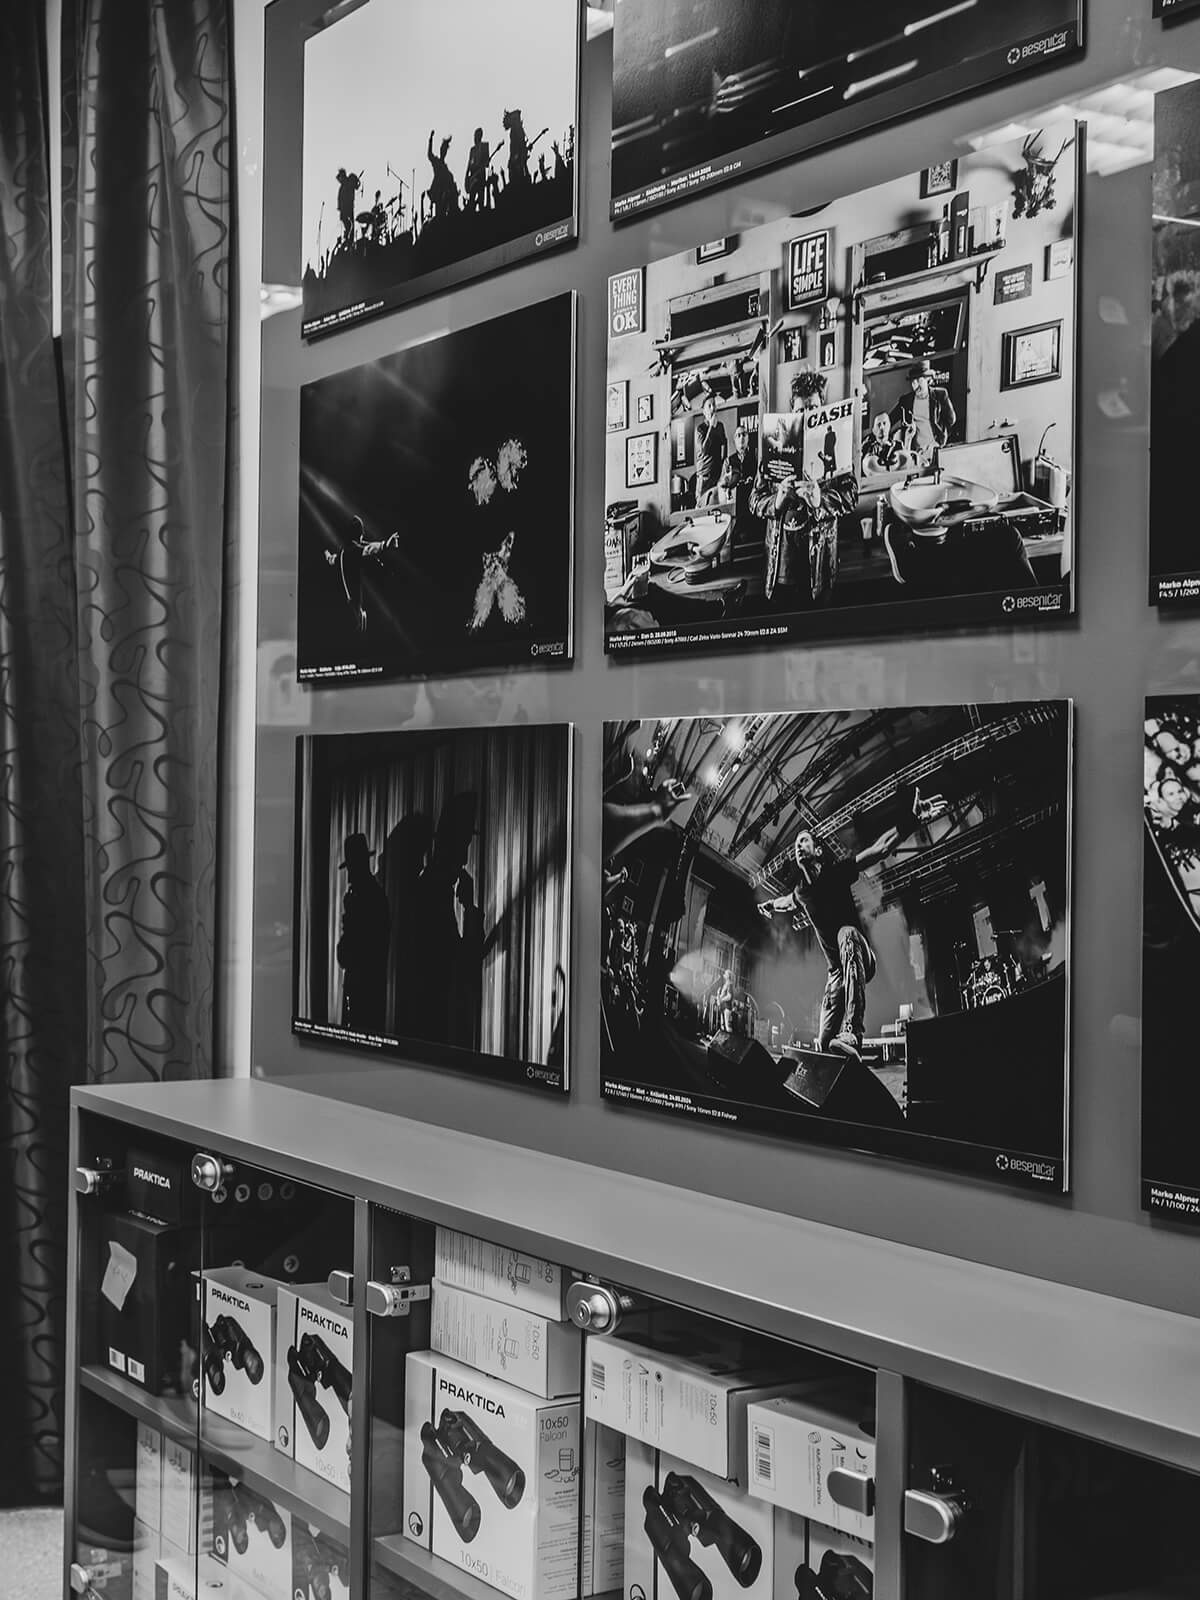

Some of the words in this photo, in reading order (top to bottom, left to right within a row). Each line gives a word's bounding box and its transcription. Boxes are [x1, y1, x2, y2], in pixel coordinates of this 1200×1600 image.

[793, 236, 825, 276] LIFE
[613, 274, 638, 295] EVERY
[793, 270, 823, 296] SIMPLE
[613, 289, 637, 310] THING
[613, 310, 638, 332] OK
[806, 402, 853, 428] CASH
[1159, 580, 1181, 590] Marko
[133, 1167, 171, 1189] PRAKTICA
[1151, 1187, 1174, 1199] Marko
[1174, 1192, 1199, 1204] Alpner
[211, 1288, 250, 1313] PRAKTICA
[301, 1307, 349, 1339] PRAKTICA
[439, 1378, 506, 1418] PRAKTICA
[540, 1416, 569, 1429] 10x50
[540, 1430, 567, 1442] Falcon
[460, 1549, 489, 1578] 10x50
